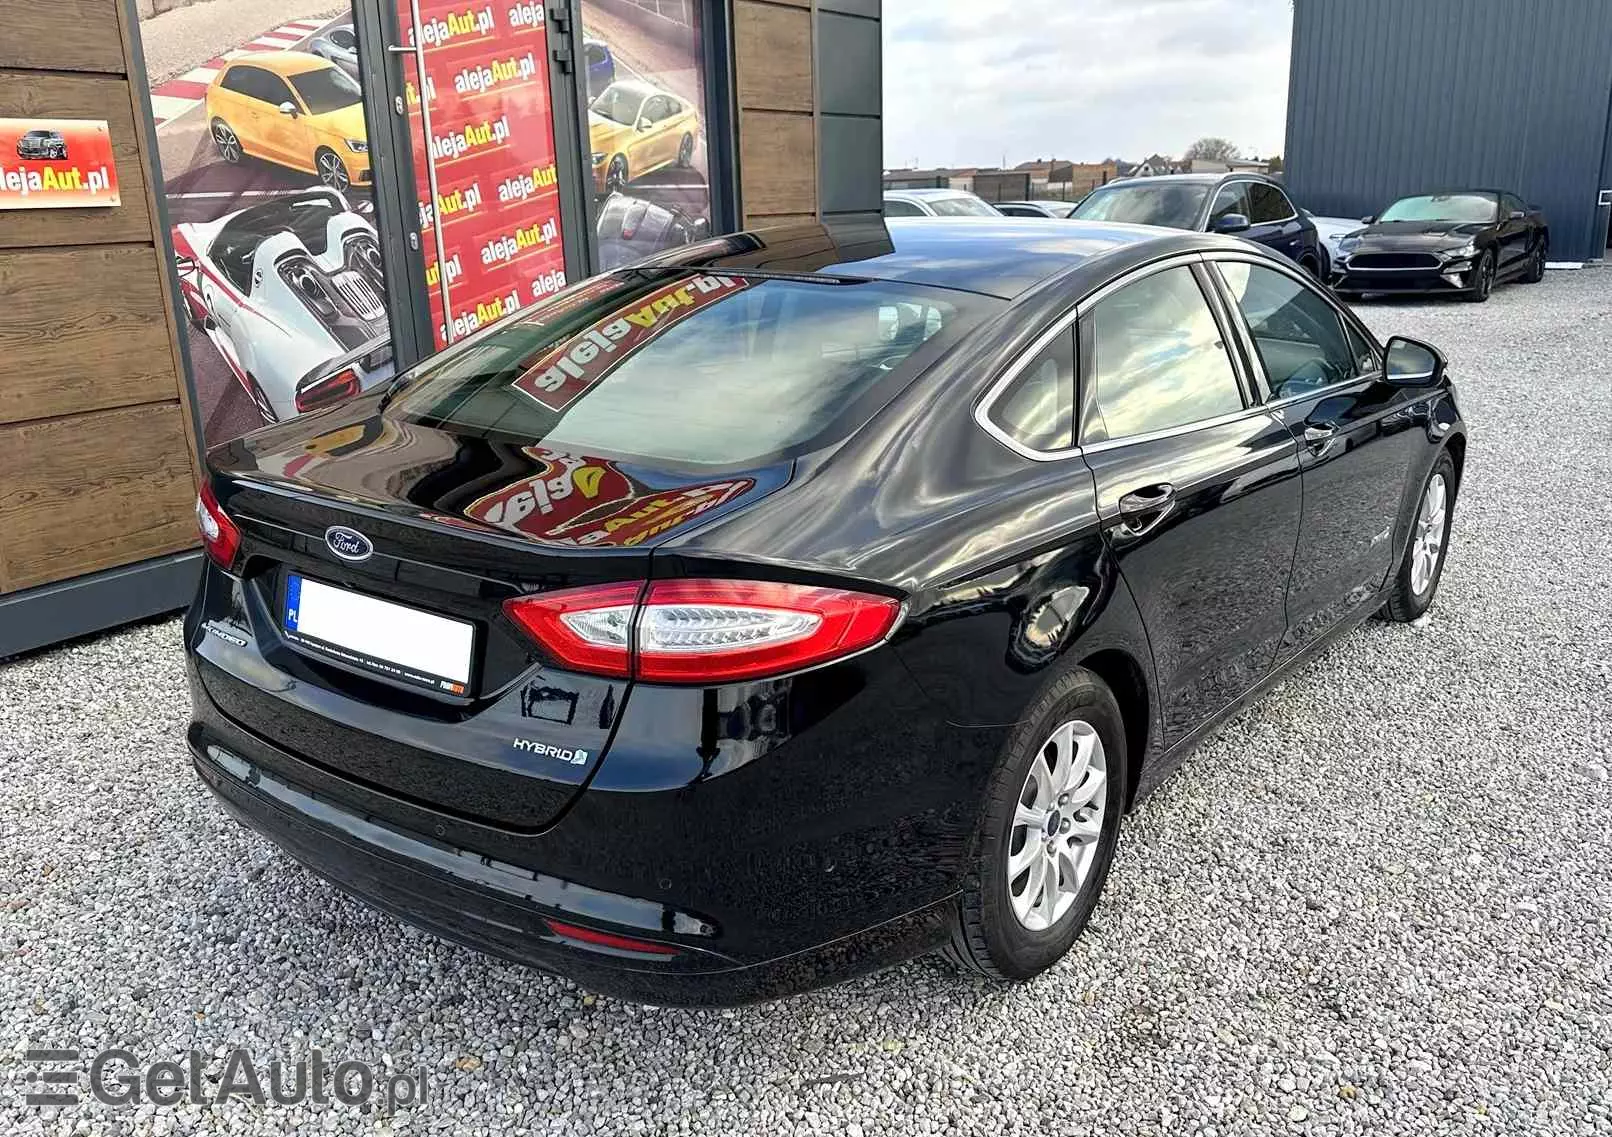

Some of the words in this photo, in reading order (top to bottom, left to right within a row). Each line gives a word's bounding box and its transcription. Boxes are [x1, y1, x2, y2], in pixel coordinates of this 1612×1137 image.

[508, 1, 544, 28] aleja
[454, 53, 536, 93] alejaAut.pl
[481, 217, 557, 265] alejaAut.pl
[531, 269, 567, 298] aleja
[333, 531, 361, 554] Ford
[288, 608, 298, 623] PL
[513, 738, 573, 762] HYBRID
